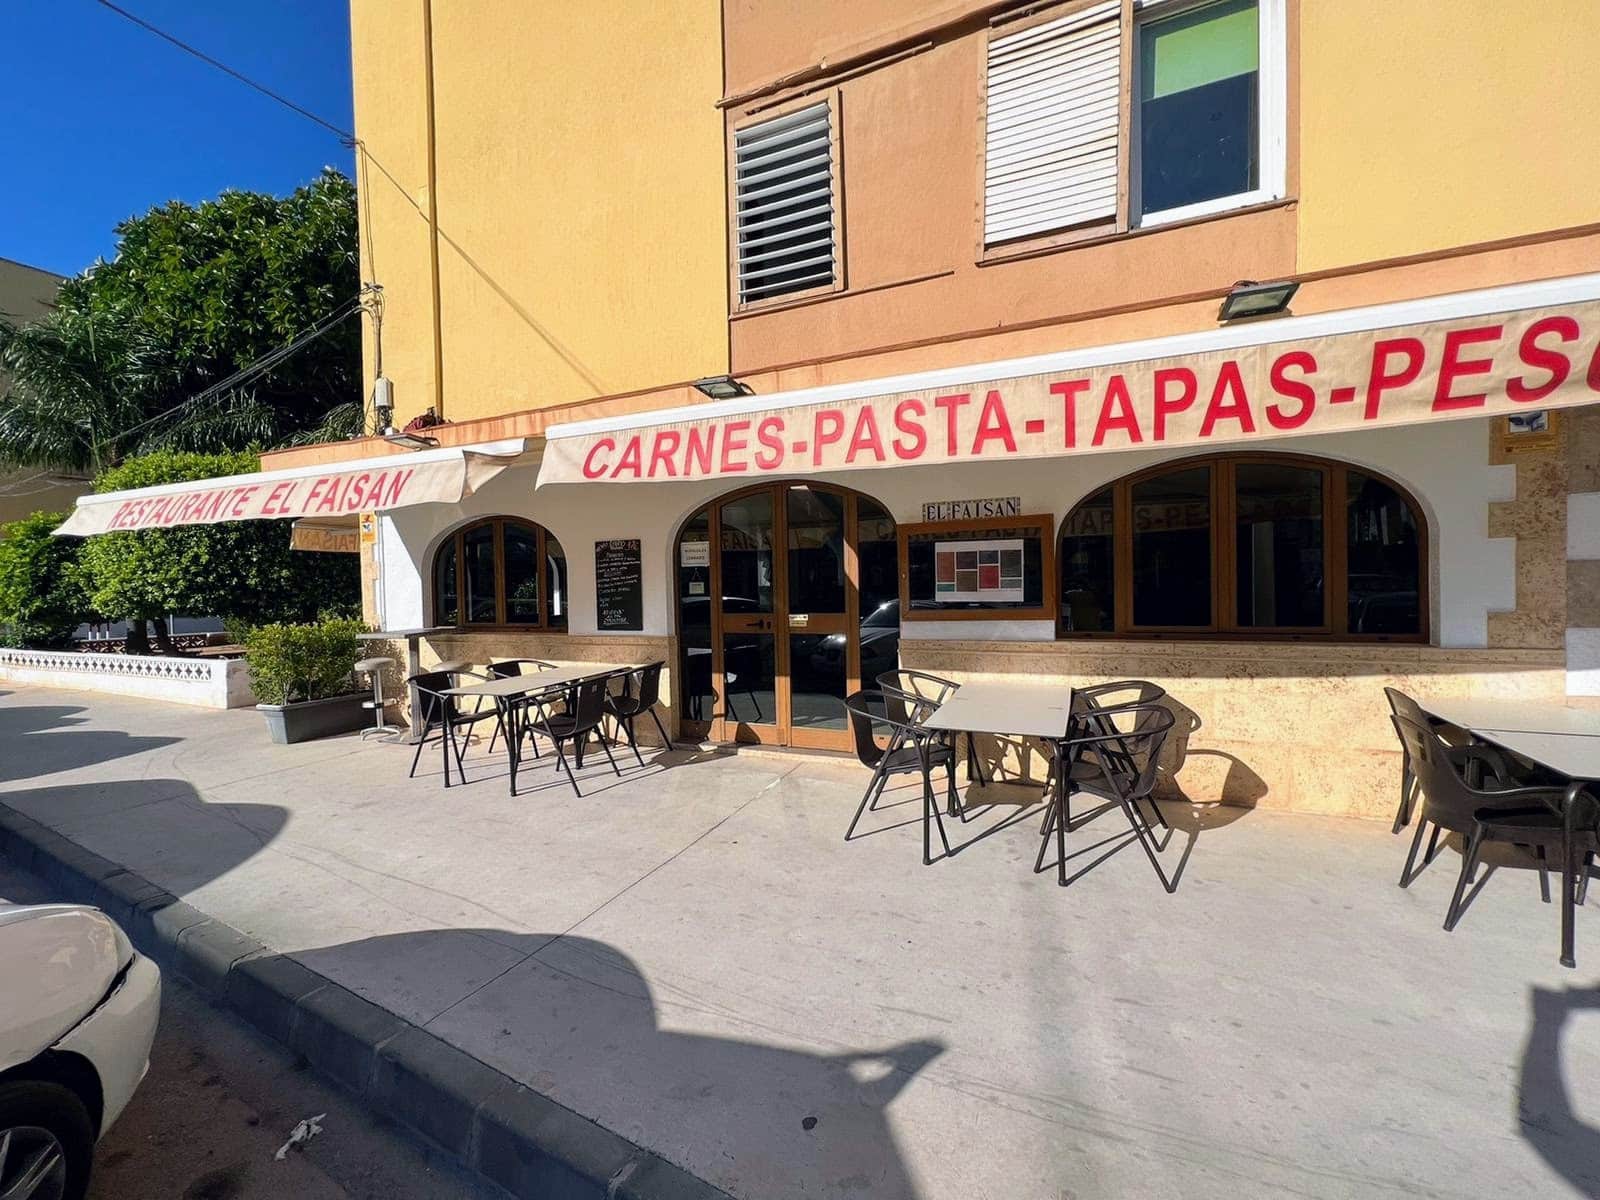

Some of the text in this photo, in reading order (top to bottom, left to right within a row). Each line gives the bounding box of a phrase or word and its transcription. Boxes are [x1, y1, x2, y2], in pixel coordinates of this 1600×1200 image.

[582, 314, 1600, 481] CARNES-PASTA-TAPAS-PES
[110, 469, 413, 529] RESTAURANTE EL FAISAN
[927, 500, 1016, 521] EL FAISAN
